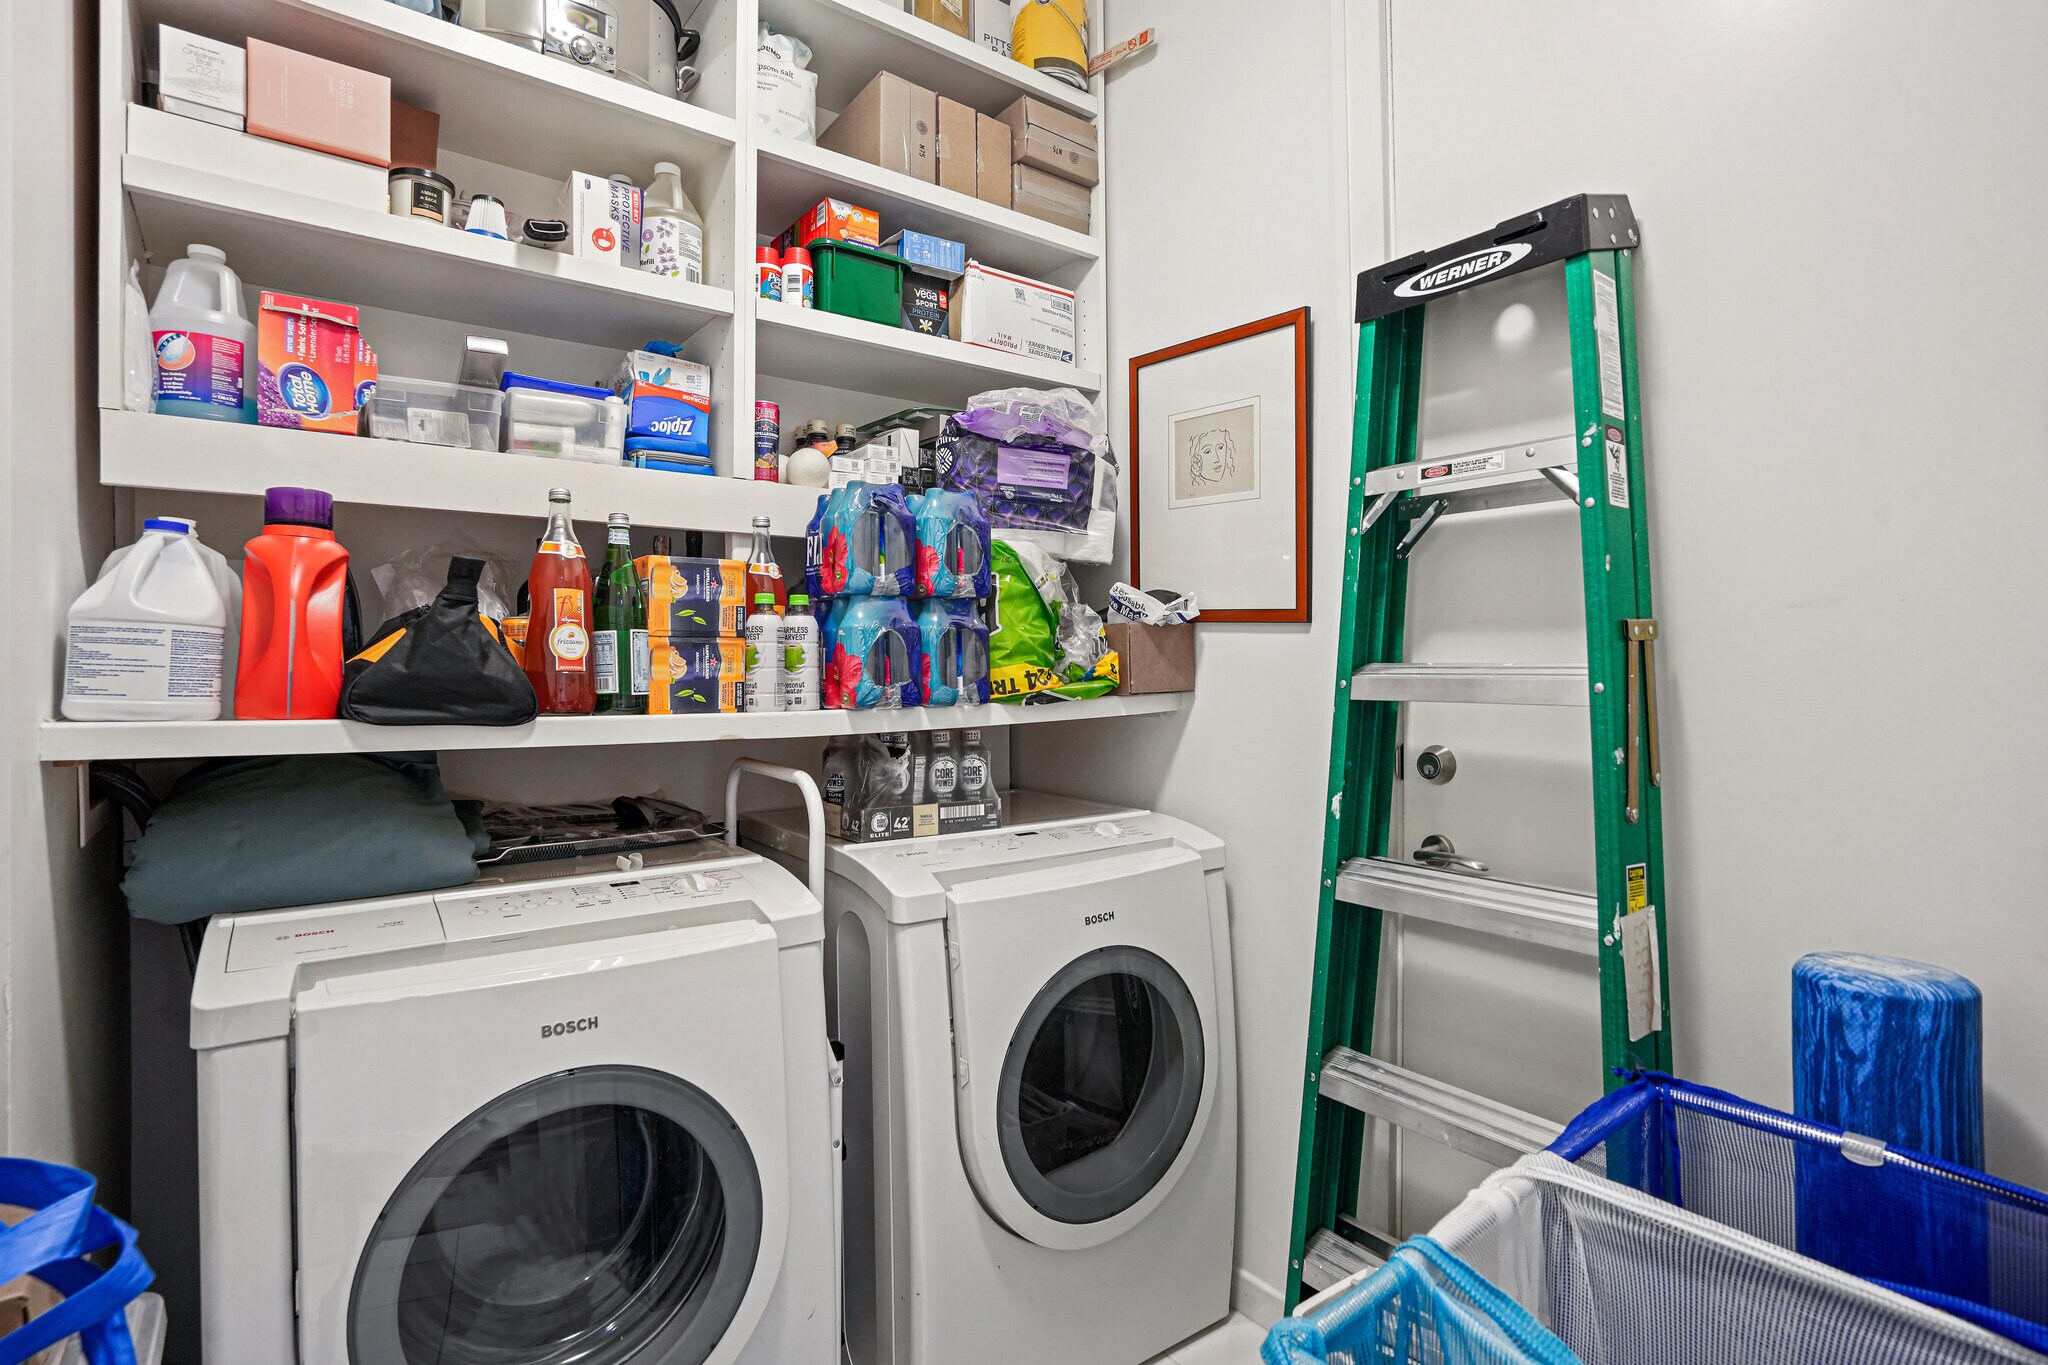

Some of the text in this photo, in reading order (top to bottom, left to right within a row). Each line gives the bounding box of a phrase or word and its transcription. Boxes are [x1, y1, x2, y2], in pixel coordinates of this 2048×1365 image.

[780, 67, 795, 79] salt
[610, 183, 620, 221] MASKS
[621, 186, 631, 253] PROTECTIVE
[1420, 251, 1503, 290] WERNER
[915, 299, 938, 310] SPORT
[912, 307, 940, 319] PROTEIN
[298, 303, 309, 357] Fabric Softeer
[997, 332, 1012, 341] MAIL
[309, 329, 317, 359] Lavender
[988, 337, 1018, 350] PRIORITY
[1028, 340, 1062, 354] POSTAL SERVICE
[1028, 348, 1060, 361] UNITED STATES
[287, 374, 306, 408] Total
[301, 370, 320, 413] Home
[650, 417, 694, 436] Ziploc
[745, 625, 764, 633] LESS
[783, 626, 809, 634] ARMLESS
[746, 633, 760, 641] VEST
[784, 633, 806, 641] ARVEST
[934, 767, 954, 779] CORE
[962, 765, 982, 777] CORE
[934, 779, 954, 788] POWER
[961, 776, 982, 785] POWER
[1084, 911, 1115, 926] BOSCH
[294, 929, 335, 938] BOSCH
[541, 1016, 599, 1039] BOSCH
